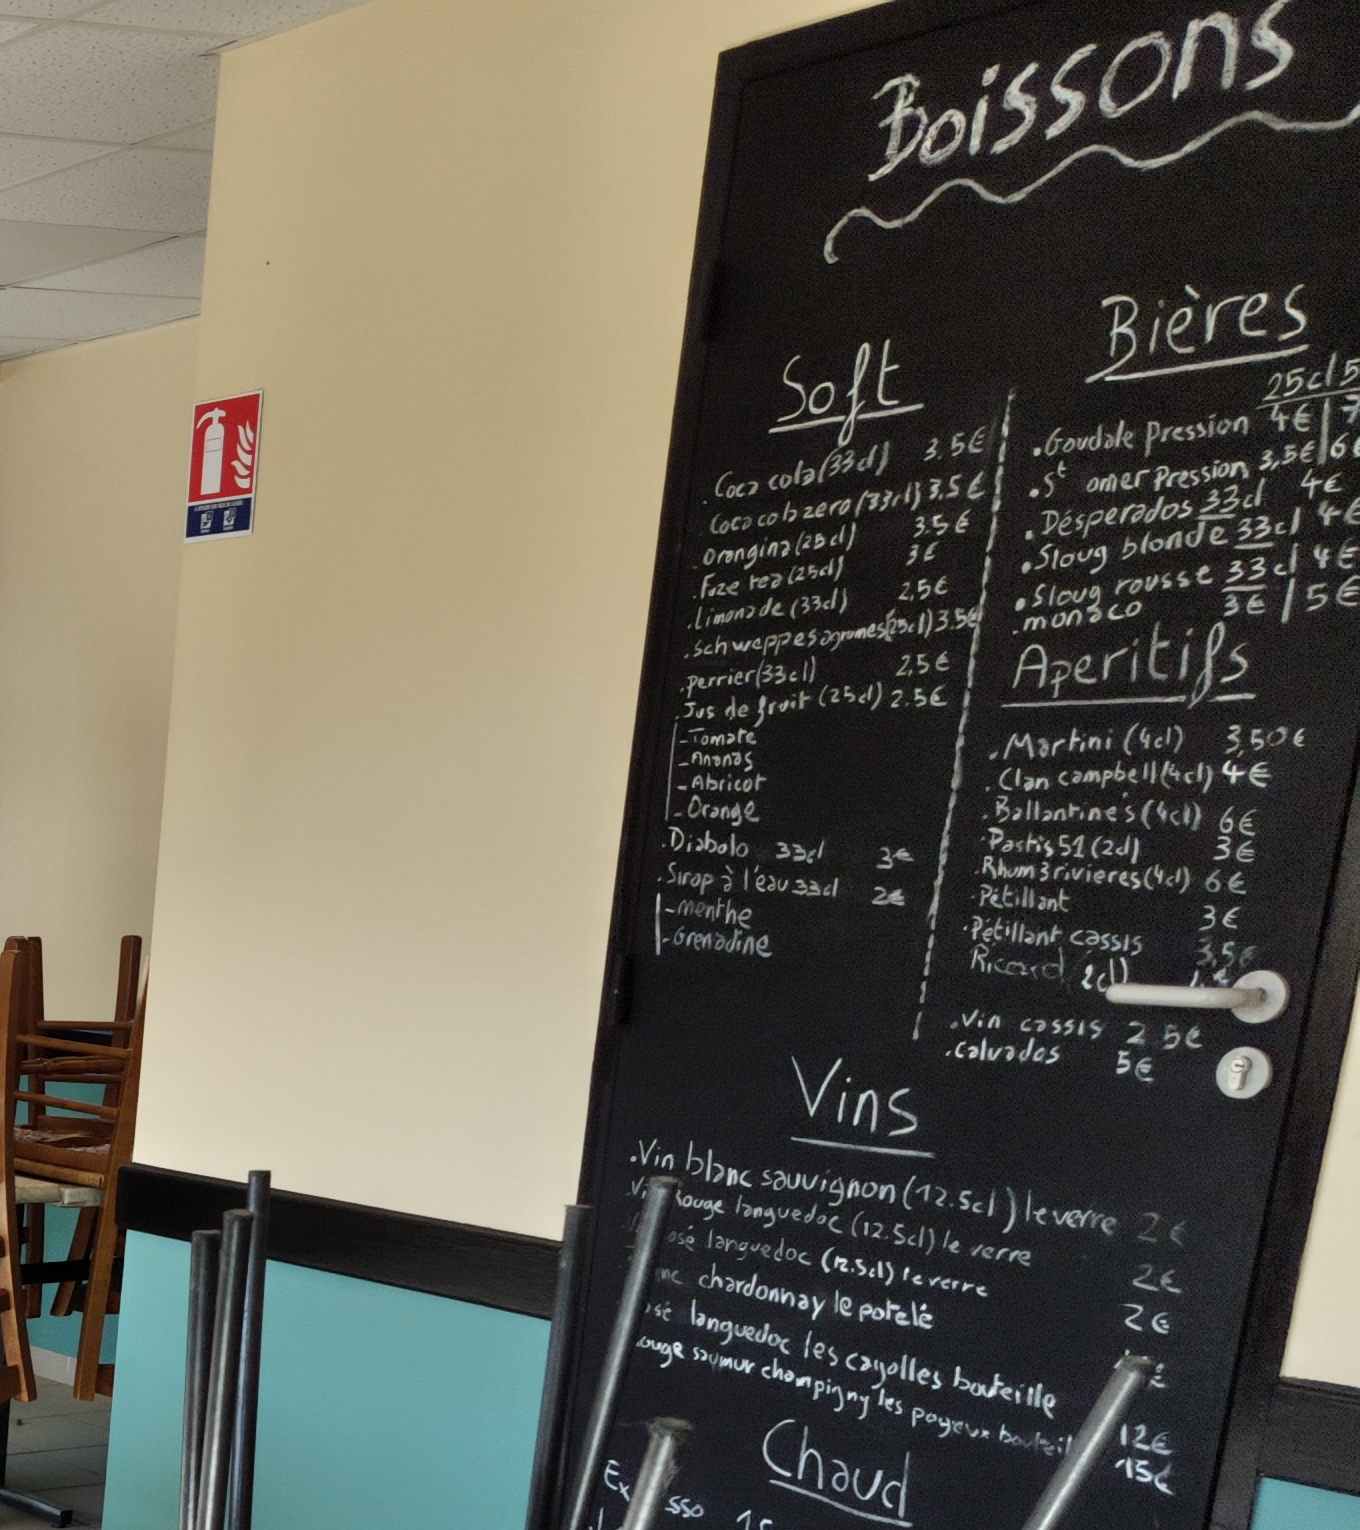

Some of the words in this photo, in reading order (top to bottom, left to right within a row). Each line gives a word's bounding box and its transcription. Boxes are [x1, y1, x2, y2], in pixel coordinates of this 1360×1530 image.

[868, 0, 1296, 182] Boissons
[1086, 284, 1309, 384] Bières
[777, 339, 900, 448] Soft
[1002, 726, 1113, 760] Martini
[791, 1055, 918, 1136] Vins
[638, 1138, 676, 1171] Vin
[684, 1139, 754, 1189] blanc
[761, 1418, 911, 1518] Chaud
